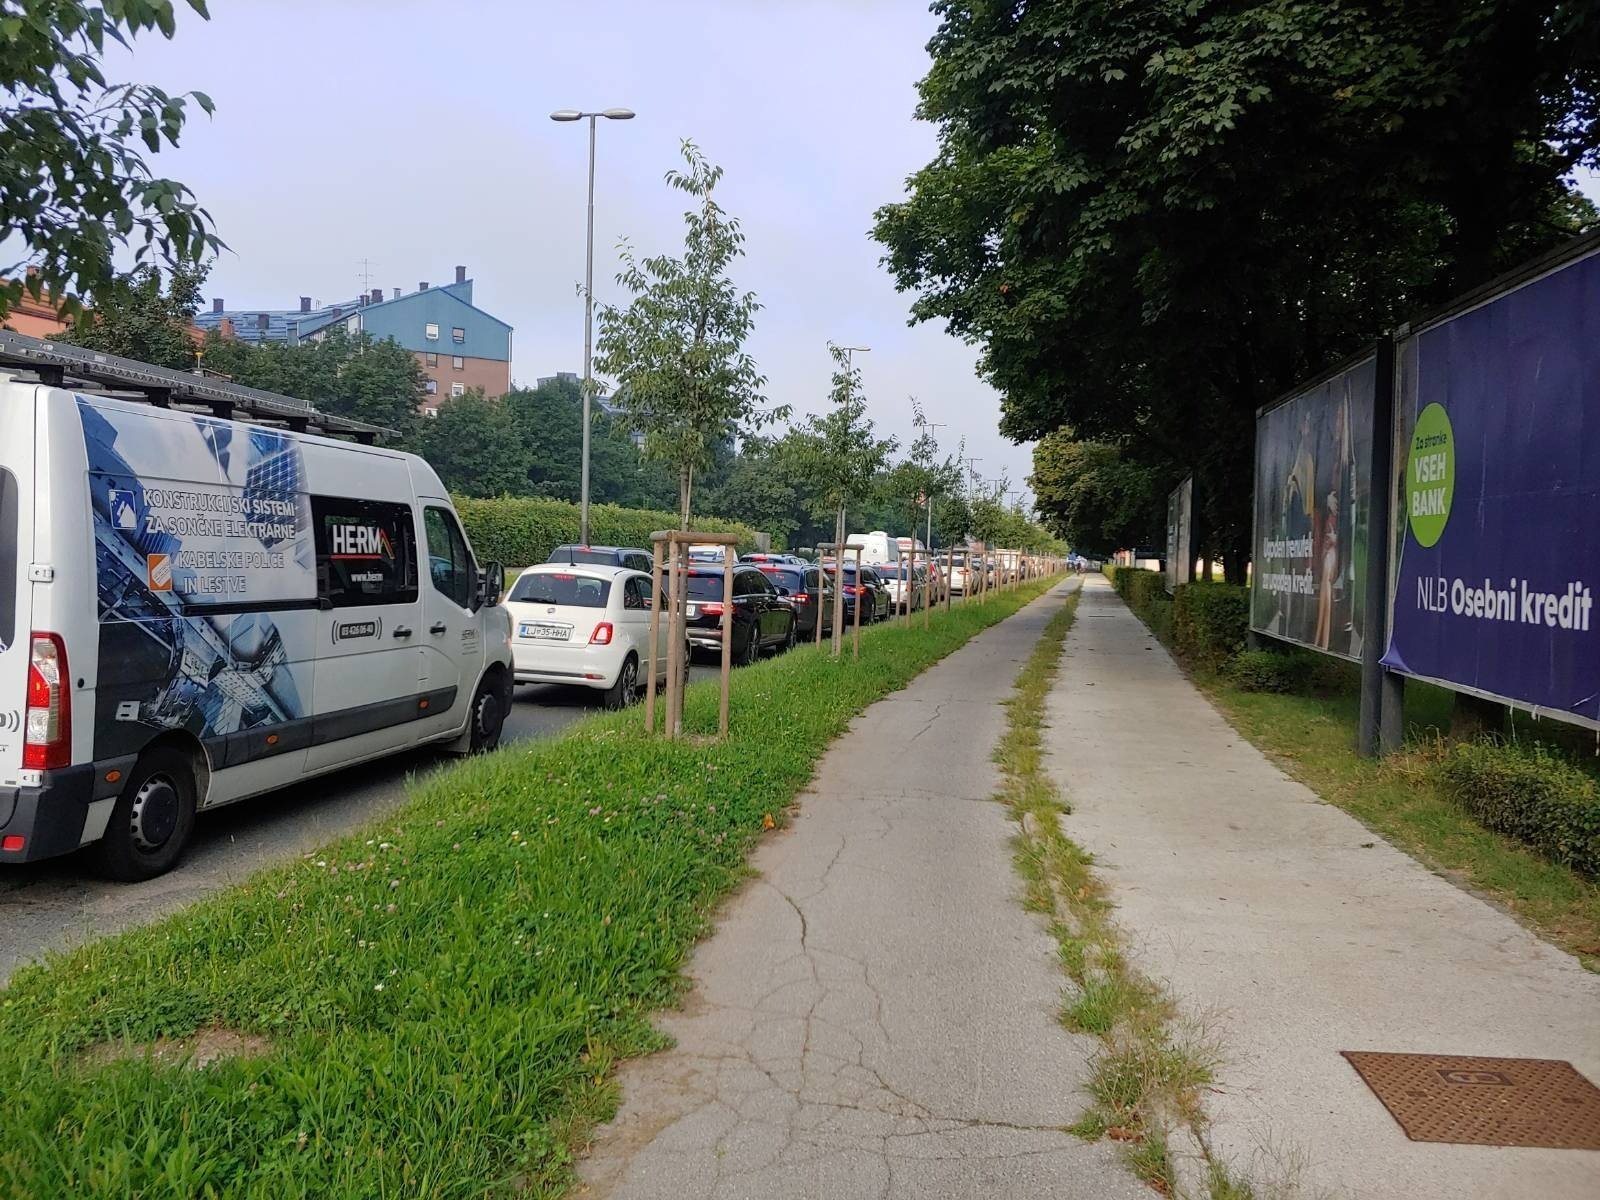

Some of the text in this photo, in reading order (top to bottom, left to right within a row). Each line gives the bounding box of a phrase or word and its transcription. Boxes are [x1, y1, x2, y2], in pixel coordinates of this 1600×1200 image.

[1415, 452, 1446, 483] VSEH
[143, 489, 295, 517] KONSTRUKCIJSKI SISTEMI
[1412, 488, 1446, 516] BANK
[146, 513, 295, 539] ZA SONČNE ELEKTRARNE
[178, 551, 284, 568] KABELSKE POLICE
[183, 576, 246, 593] IN LESTVE
[1417, 576, 1592, 631] NLB Osebni kredit
